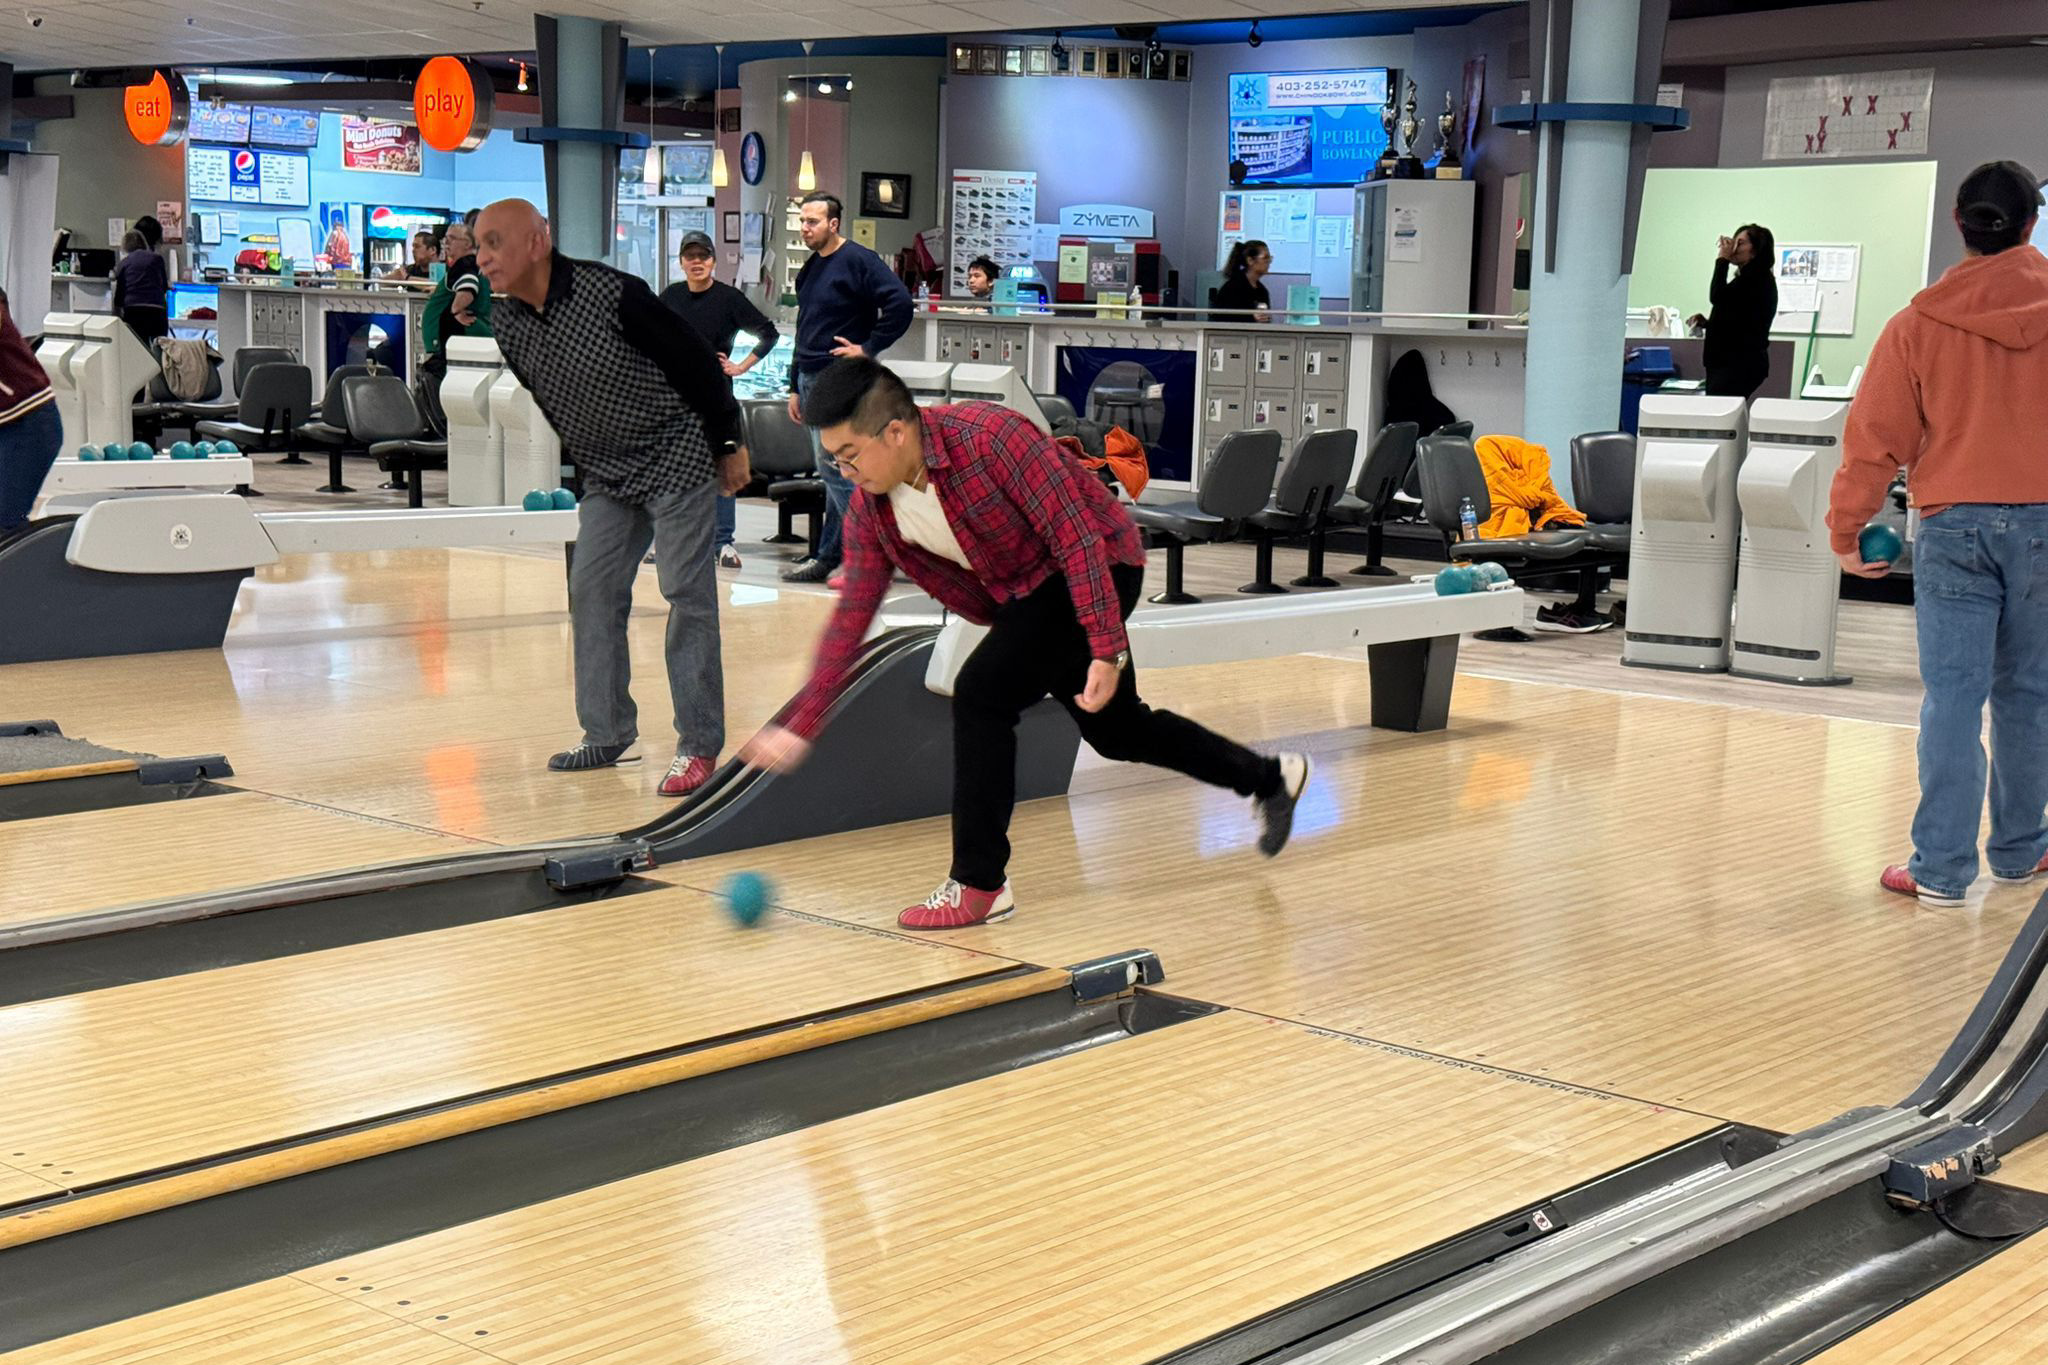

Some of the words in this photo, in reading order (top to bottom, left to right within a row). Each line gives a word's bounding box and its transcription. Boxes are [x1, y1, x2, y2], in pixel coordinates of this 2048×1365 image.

[1276, 79, 1367, 91] 403-252-5747
[136, 97, 161, 117] eat
[425, 88, 464, 118] play
[346, 129, 368, 143] Mini
[368, 126, 402, 141] Donuts
[1322, 129, 1383, 145] PUBLIC
[1010, 266, 1033, 278] ATM
[1304, 1028, 1339, 1039] LINE
[1343, 1036, 1380, 1048] FOUL
[1380, 1045, 1433, 1061] CROSS
[1433, 1058, 1469, 1068] NOT
[1470, 1066, 1495, 1075] DO
[1505, 1073, 1574, 1092] HAZARD
[1573, 1090, 1612, 1101] SLIP
